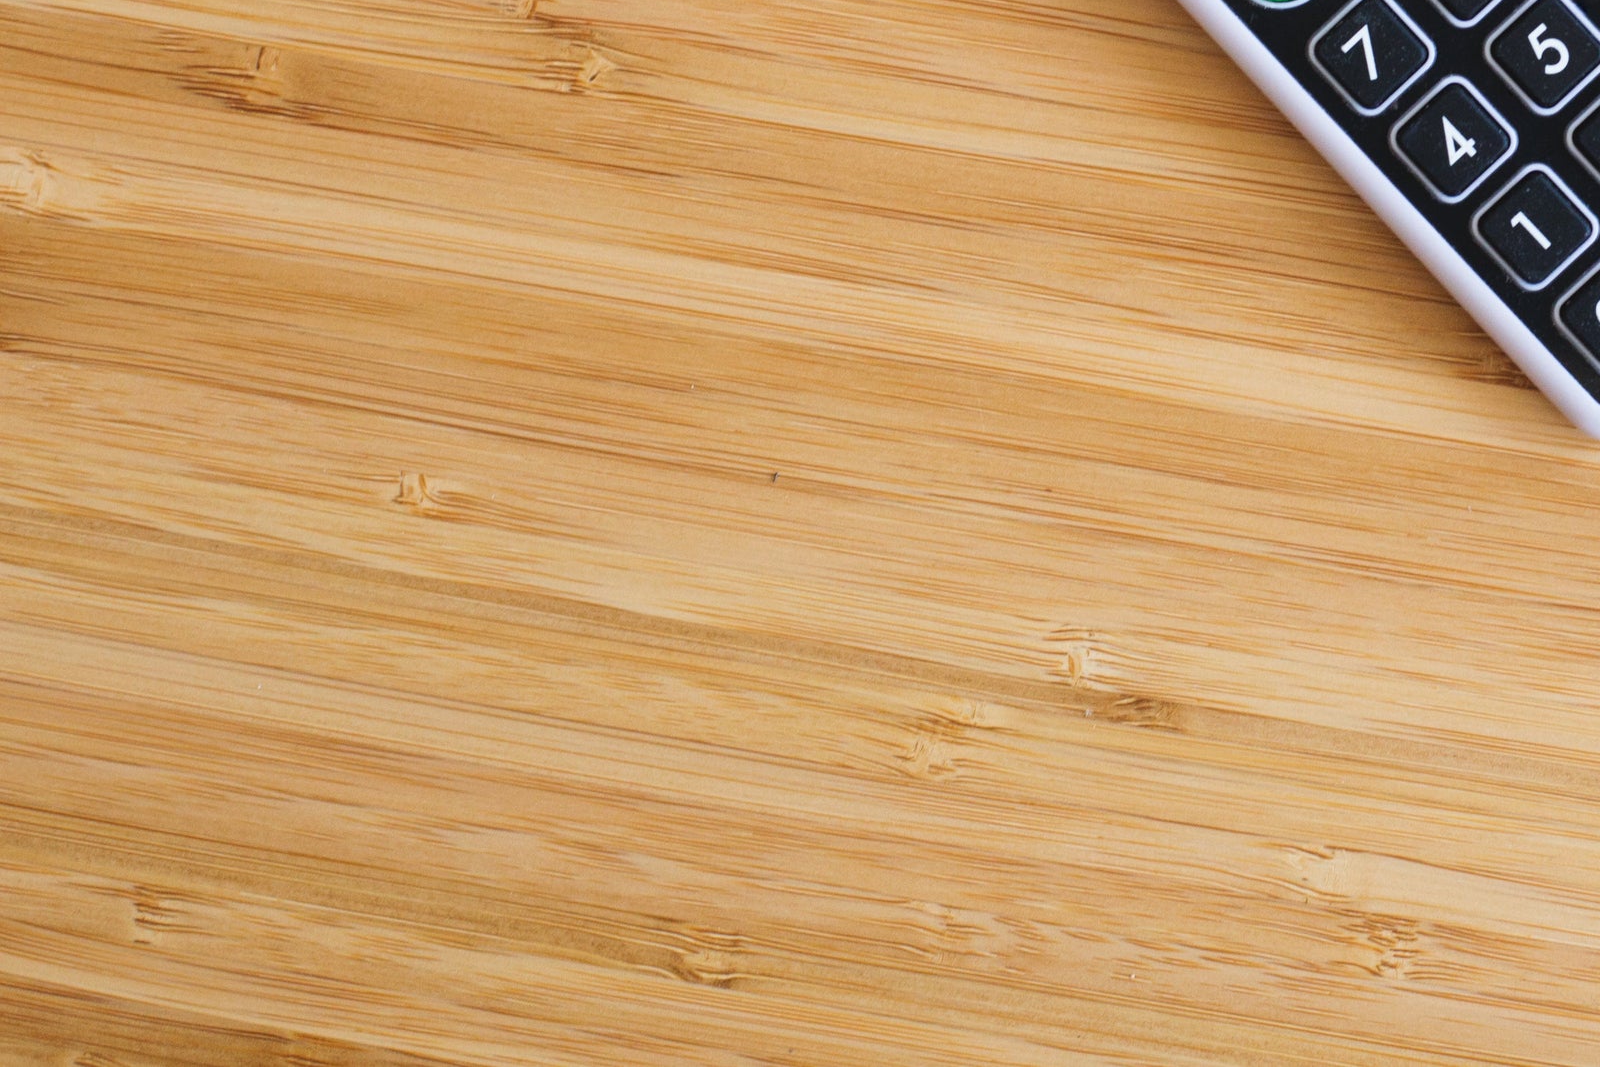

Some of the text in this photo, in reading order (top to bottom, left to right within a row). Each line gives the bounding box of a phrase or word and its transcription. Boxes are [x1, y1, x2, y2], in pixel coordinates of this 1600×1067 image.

[1340, 24, 1378, 81] 7
[1527, 23, 1570, 75] 5
[1441, 116, 1477, 167] 4
[1510, 211, 1552, 250] 1
